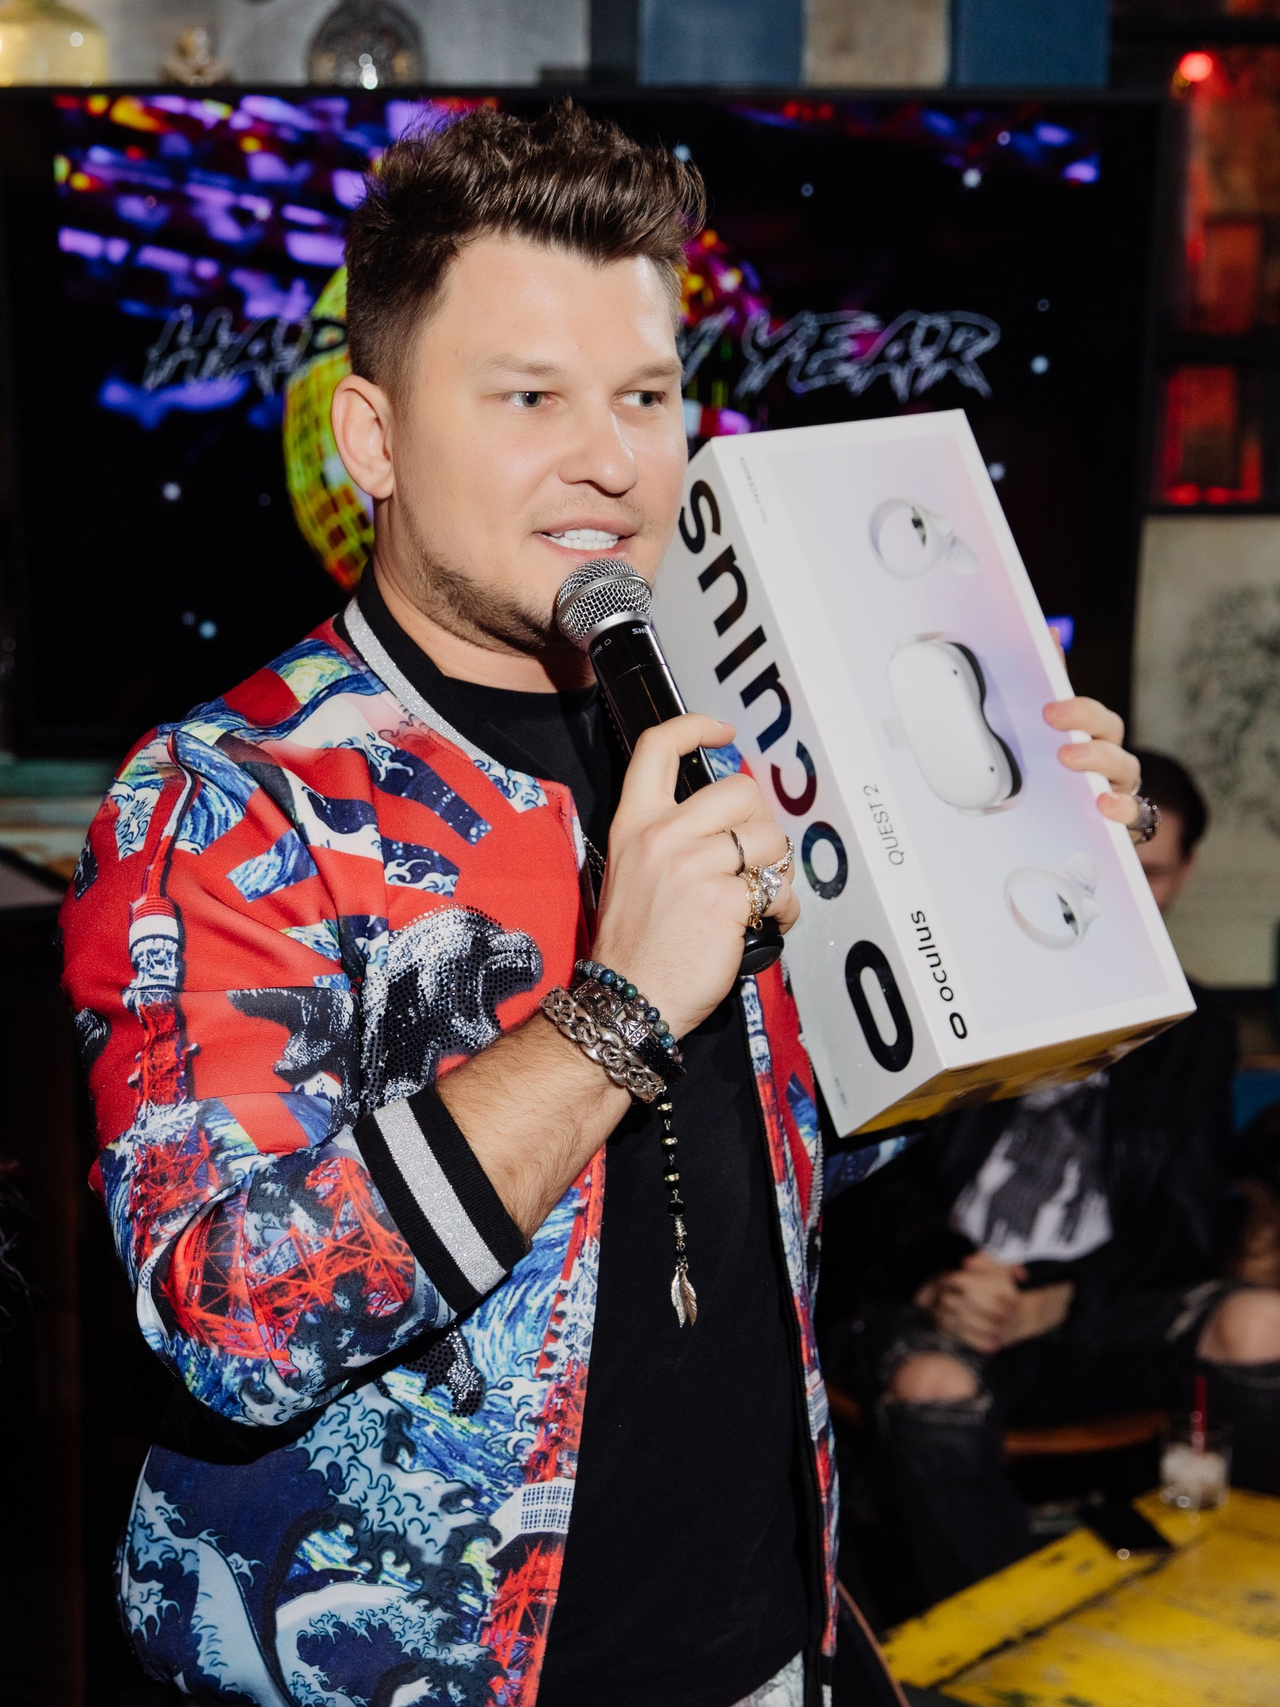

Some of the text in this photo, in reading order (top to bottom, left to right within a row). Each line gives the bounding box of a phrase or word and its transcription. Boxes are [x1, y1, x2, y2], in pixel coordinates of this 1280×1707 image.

[733, 308, 1001, 402] YEAR
[679, 479, 848, 900] oculus
[863, 783, 905, 866] QUEST 2
[910, 910, 954, 1002] oculus
